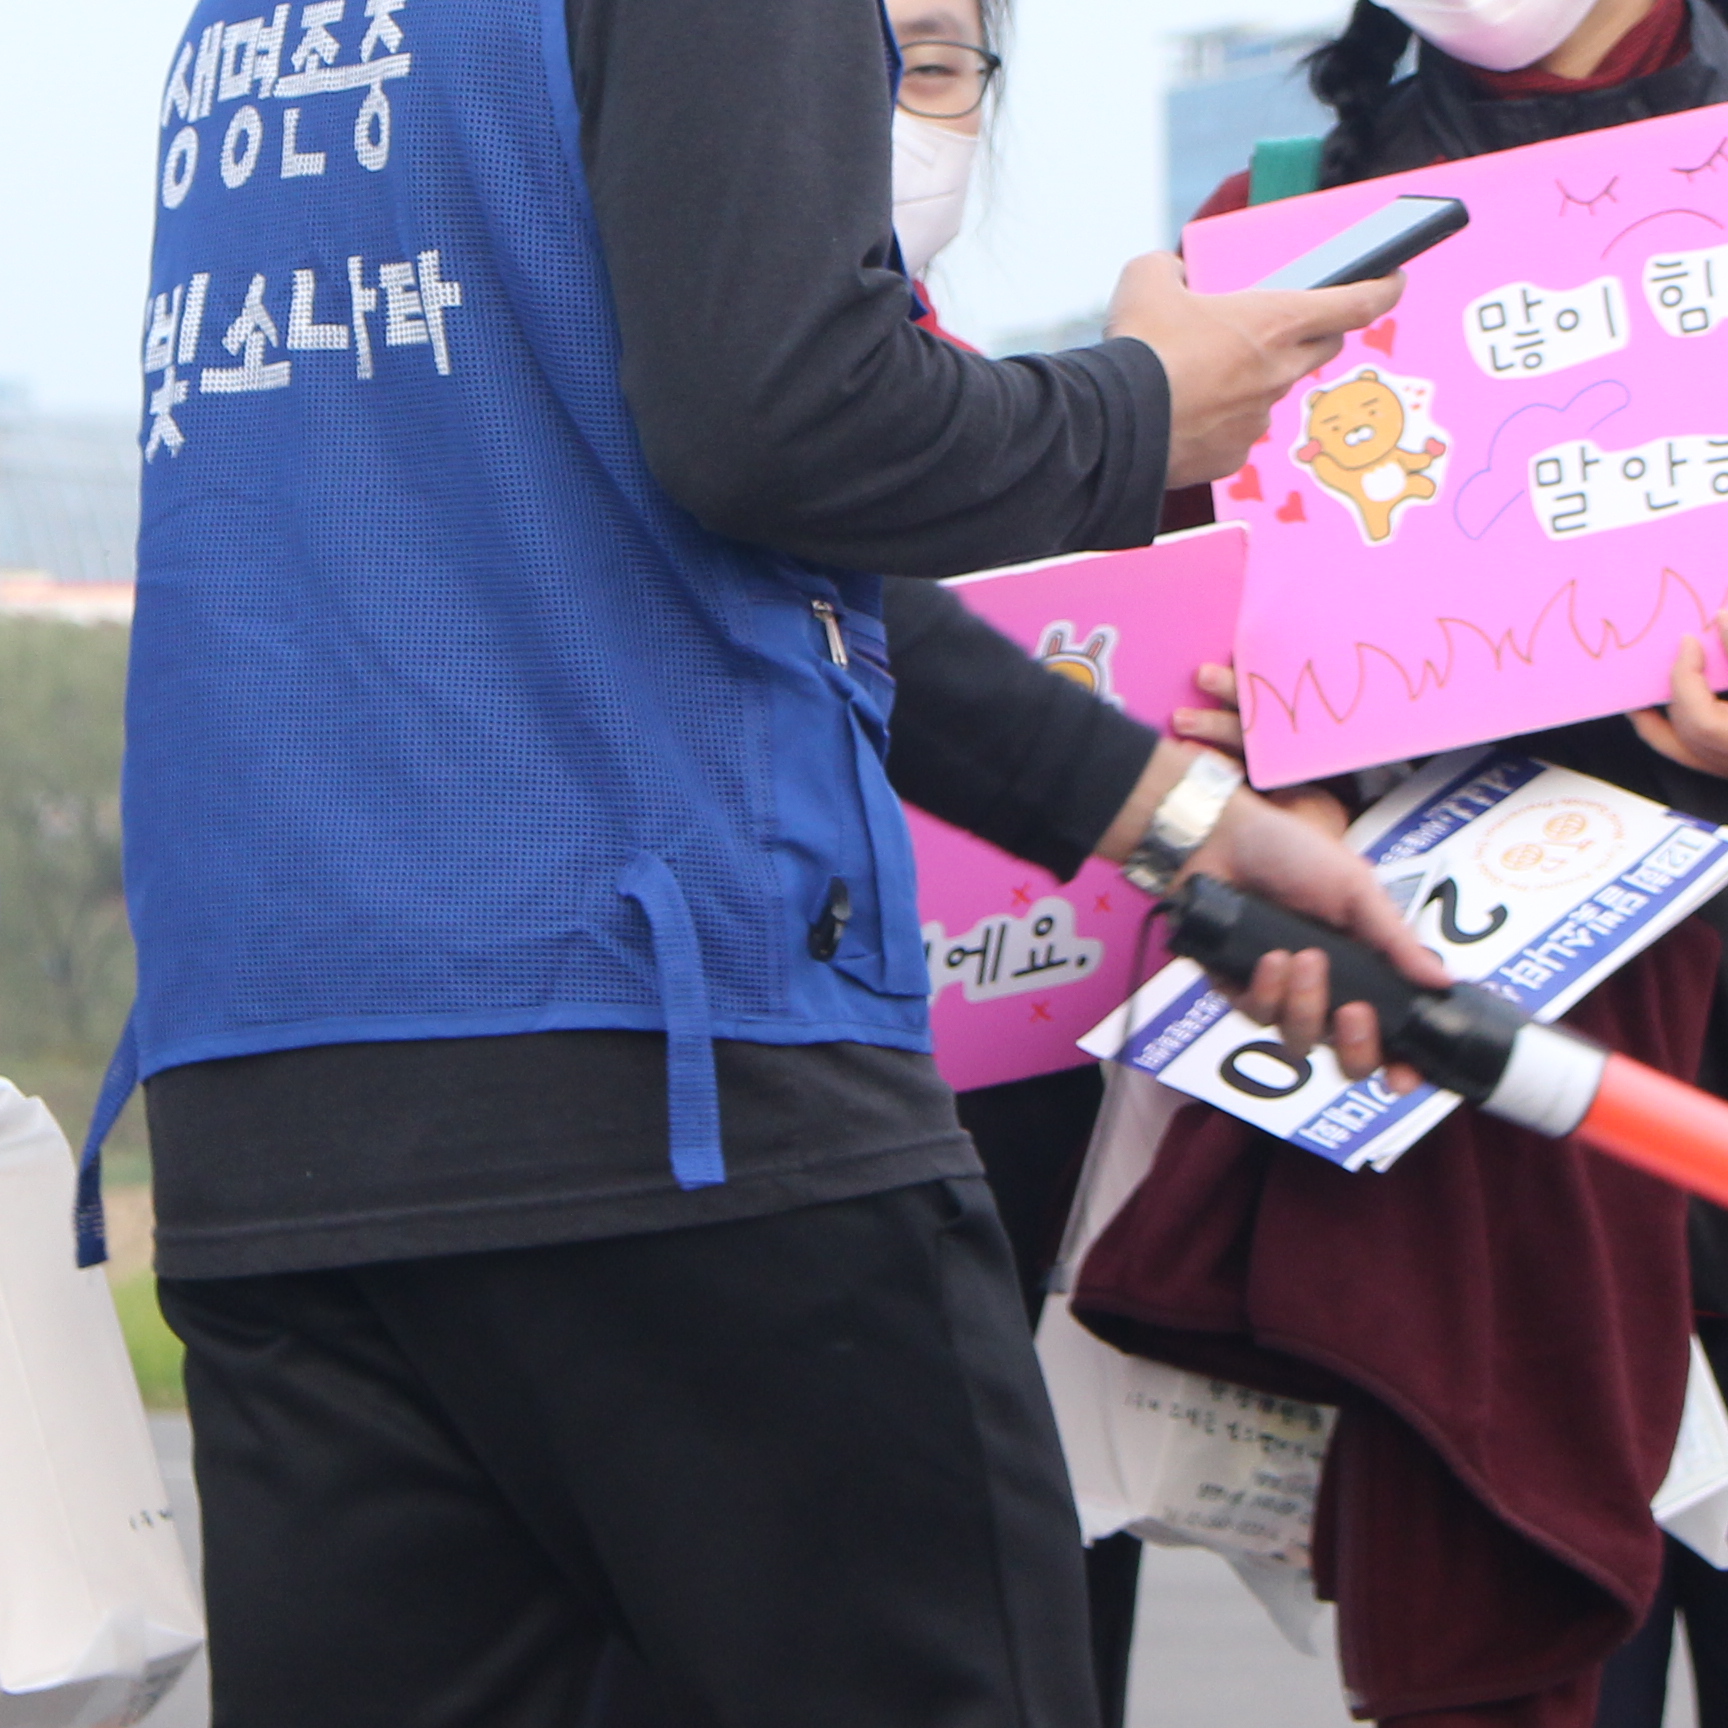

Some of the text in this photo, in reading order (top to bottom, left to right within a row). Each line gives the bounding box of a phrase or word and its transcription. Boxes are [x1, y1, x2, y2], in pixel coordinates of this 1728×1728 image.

[1477, 285, 1621, 371] 많이
[925, 915, 1088, 987] 에요.
[1298, 1069, 1398, 1150] 기대회
